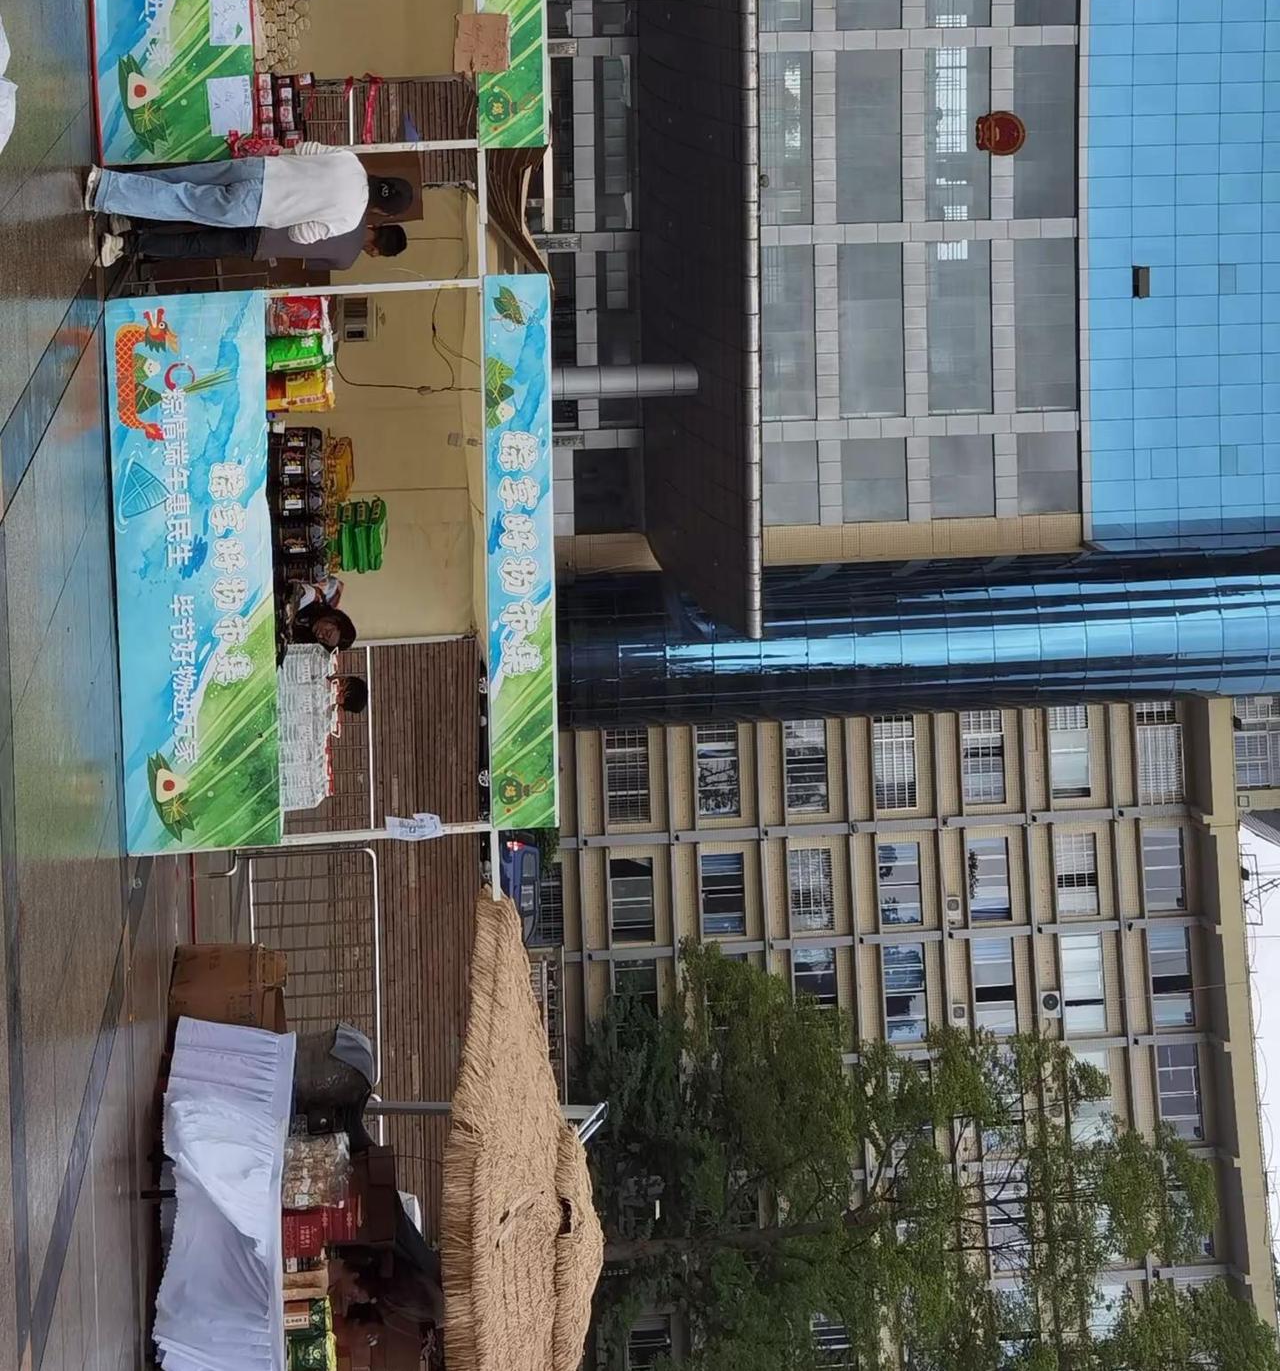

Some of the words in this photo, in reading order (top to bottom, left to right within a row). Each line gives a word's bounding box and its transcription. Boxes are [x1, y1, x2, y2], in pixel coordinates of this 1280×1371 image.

[160, 390, 193, 568] 粽情端午惠民生
[209, 462, 253, 686] 粽享好物市集
[497, 431, 542, 678] 粽享好物市集
[168, 595, 200, 764] 毕节好物进万家
